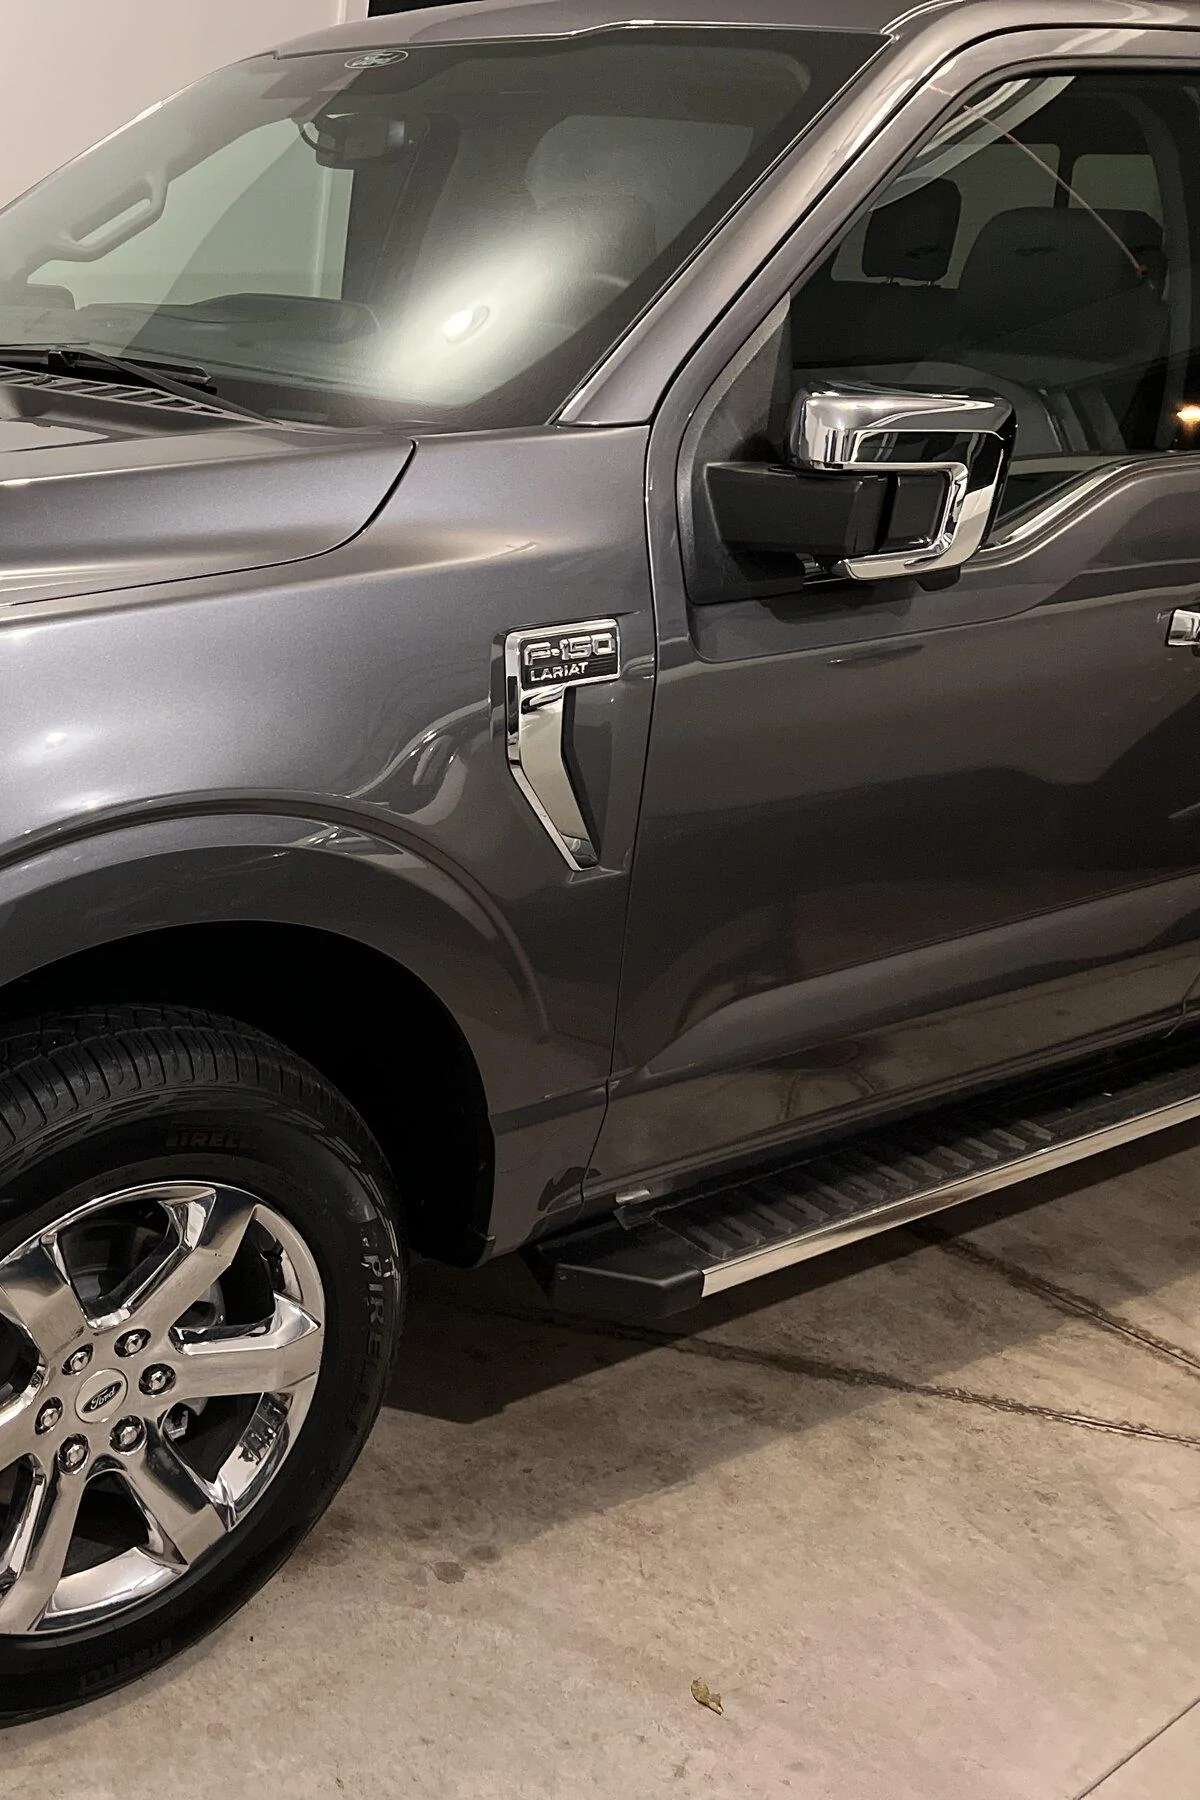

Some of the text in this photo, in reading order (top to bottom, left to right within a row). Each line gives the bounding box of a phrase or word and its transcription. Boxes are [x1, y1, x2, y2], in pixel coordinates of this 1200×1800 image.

[524, 633, 616, 666] F-150
[530, 662, 588, 682] LARIAT
[90, 1386, 116, 1410] Ford
